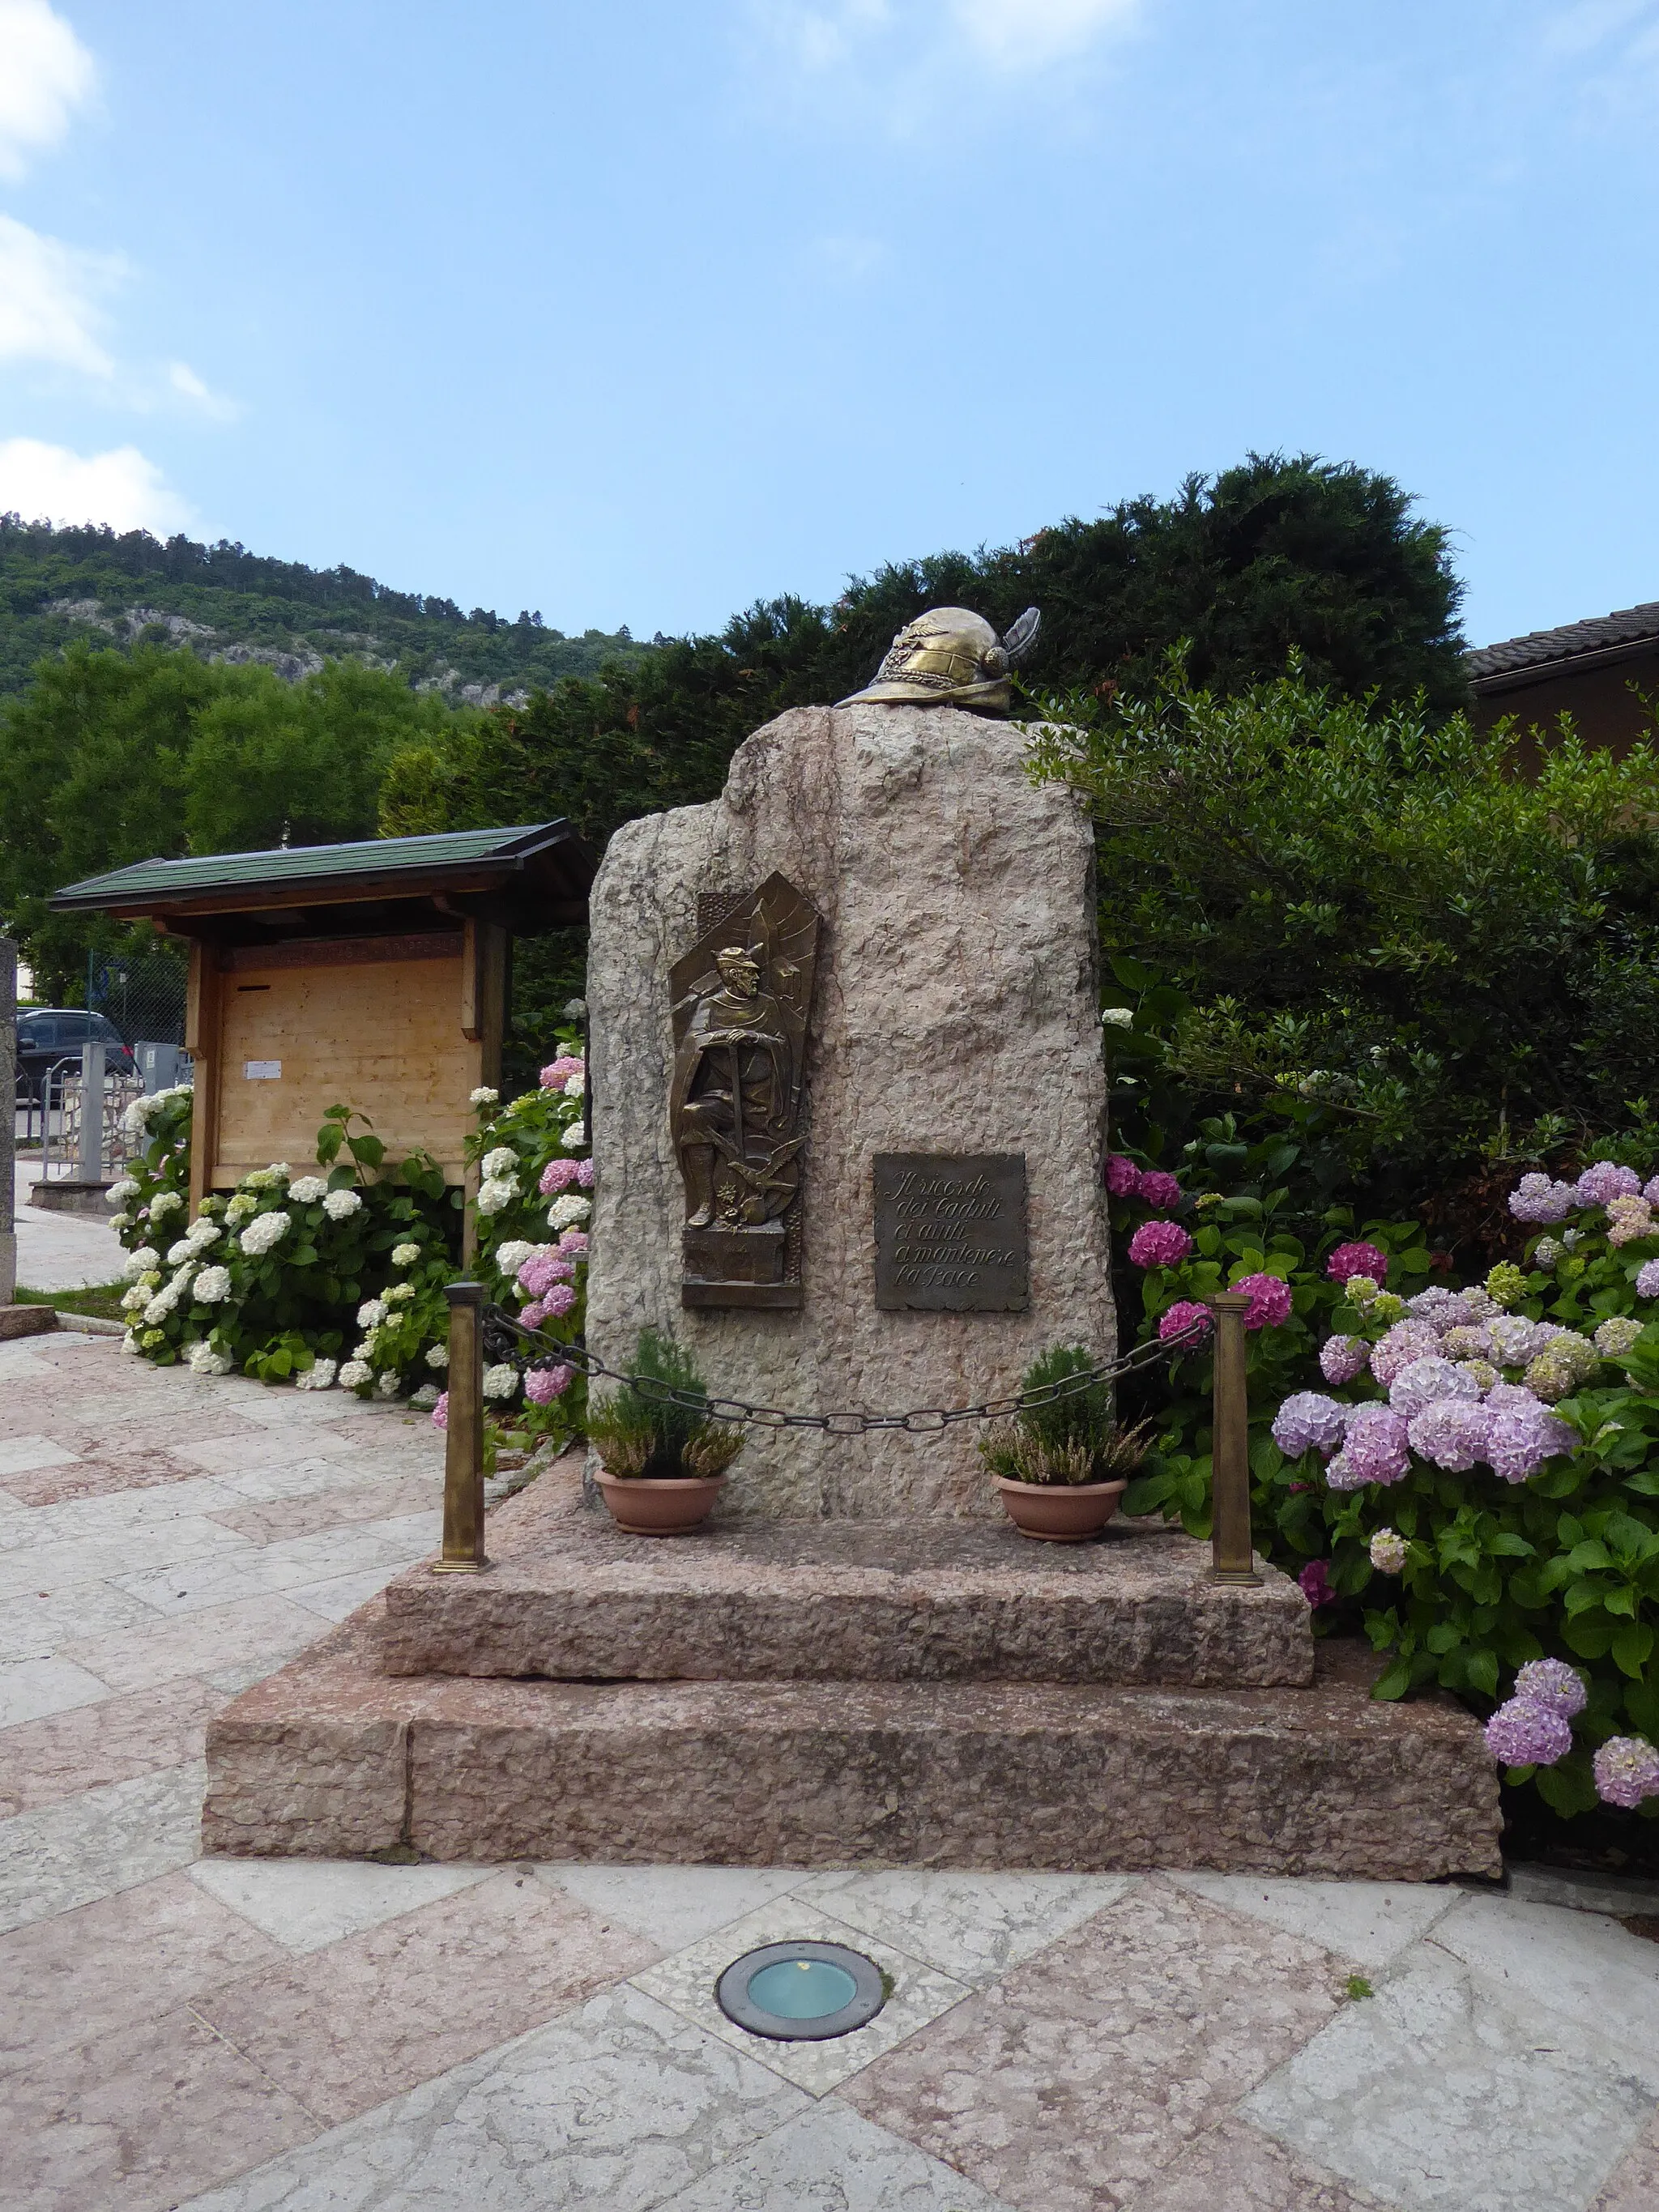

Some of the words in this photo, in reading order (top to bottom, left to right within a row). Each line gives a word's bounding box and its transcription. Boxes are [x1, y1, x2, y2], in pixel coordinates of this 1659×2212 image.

[884, 1170, 917, 1201] Il
[919, 1174, 993, 1197] ricordo
[896, 1196, 929, 1218] dei
[933, 1197, 1005, 1221] Caduti
[894, 1220, 914, 1240] ci
[918, 1220, 973, 1242] aiuti
[895, 1246, 910, 1264] a
[914, 1242, 1015, 1267] mantenere
[895, 1264, 919, 1286] la
[922, 1265, 981, 1288] Pace
